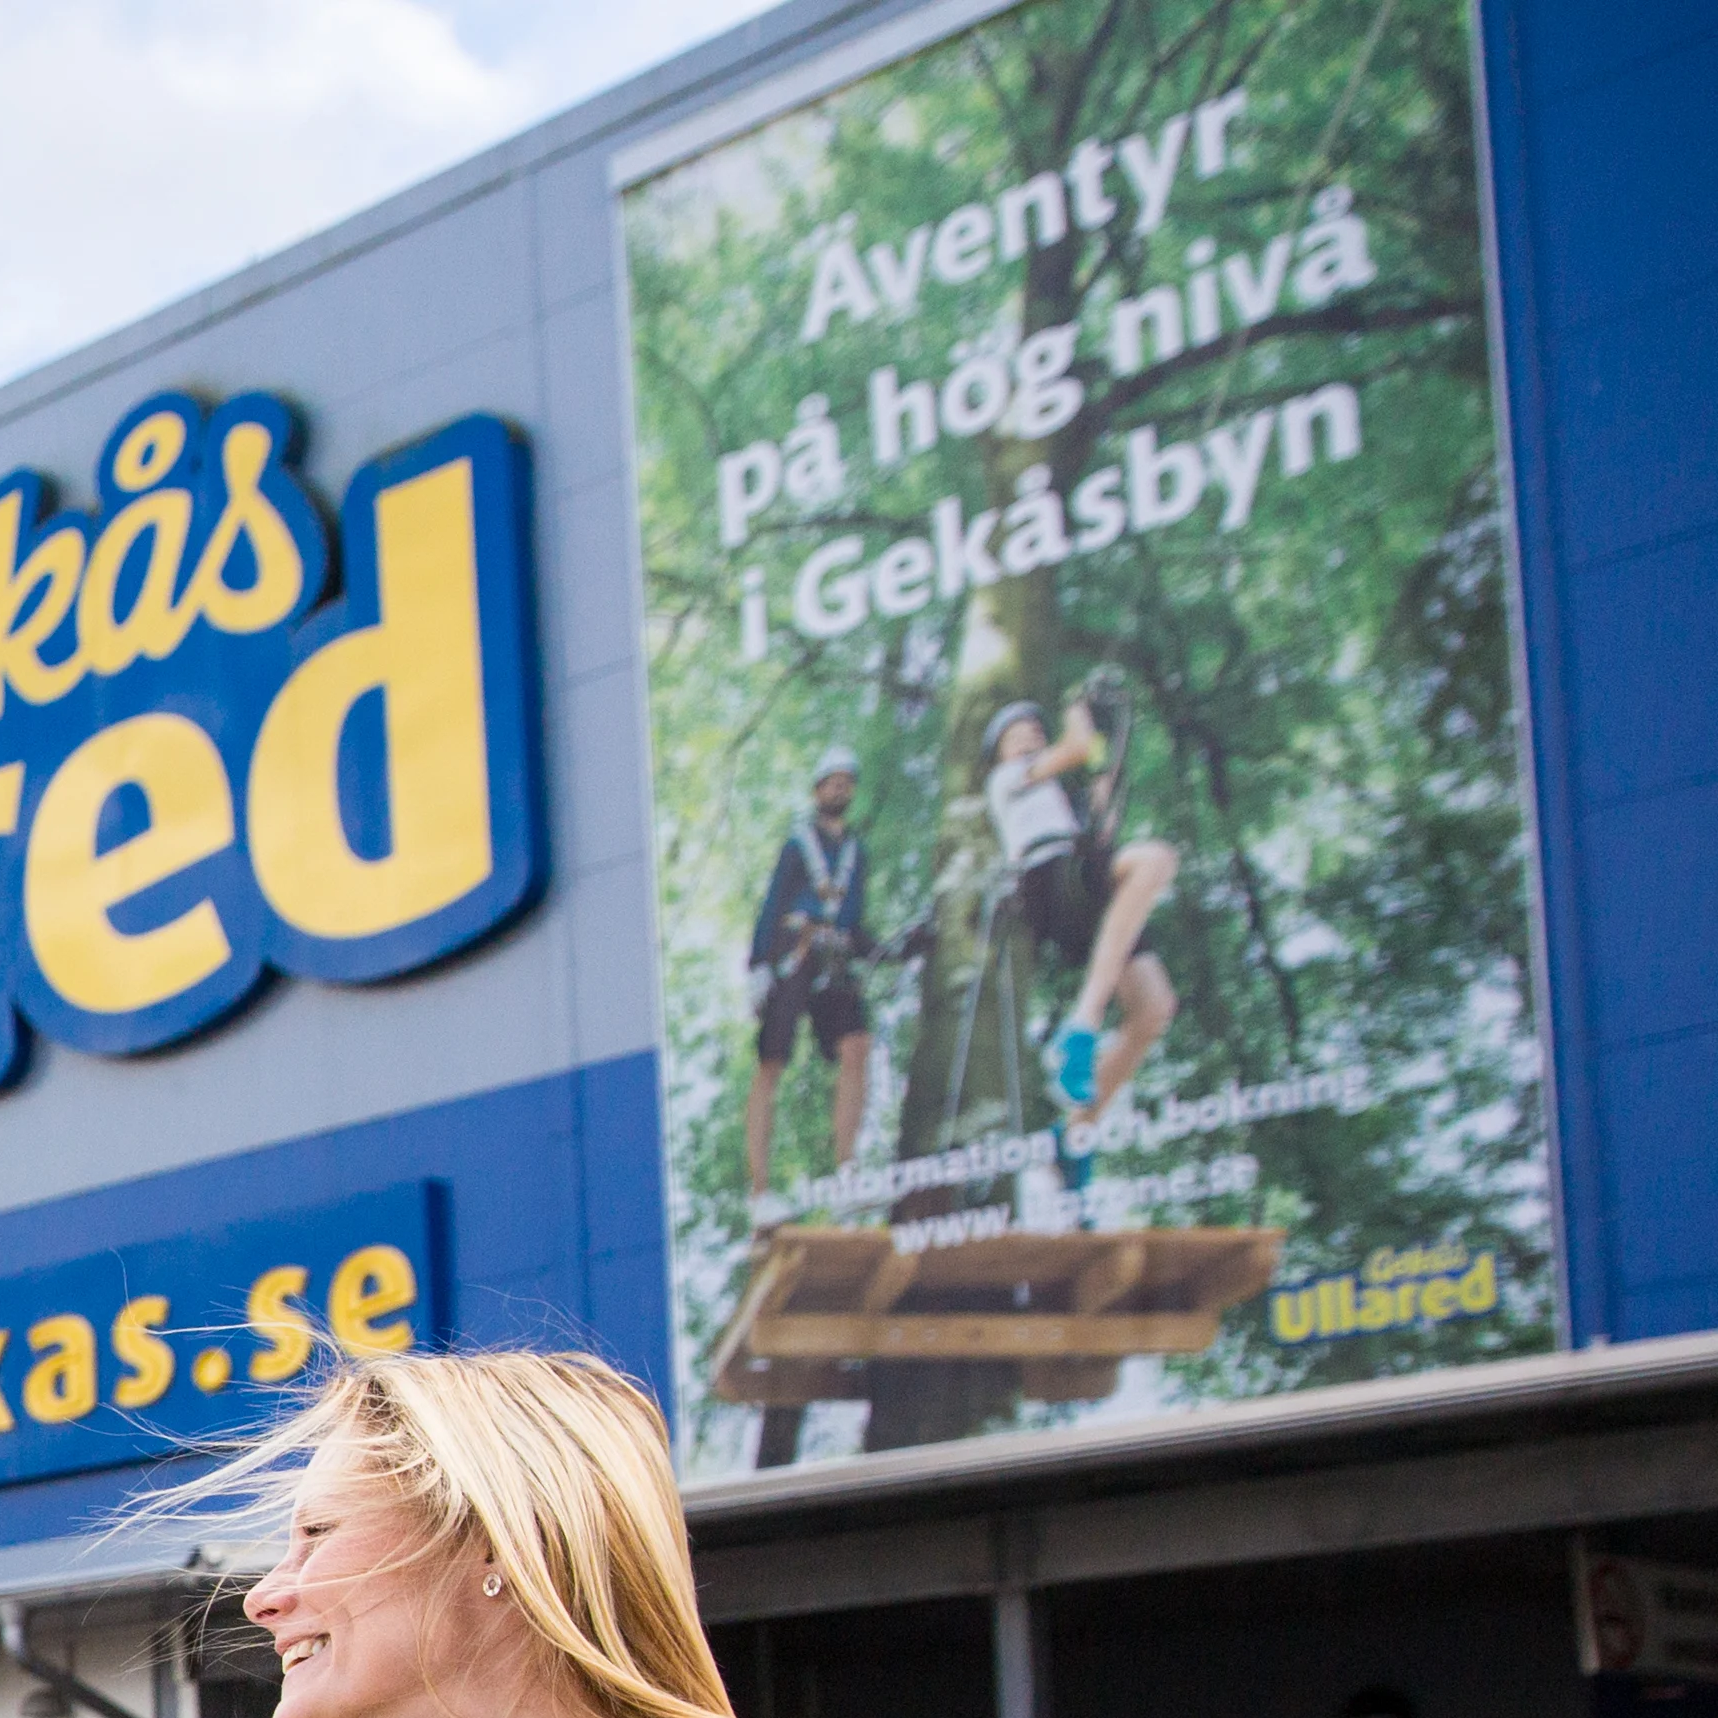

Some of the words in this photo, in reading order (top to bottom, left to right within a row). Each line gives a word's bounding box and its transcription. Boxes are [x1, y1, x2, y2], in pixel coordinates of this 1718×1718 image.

[802, 86, 1247, 343] Äventyr
[717, 392, 847, 549] på
[867, 320, 1087, 468] hög
[1111, 183, 1379, 378] nivå
[739, 564, 770, 664] i
[792, 377, 1364, 640] Gekåsbyn
